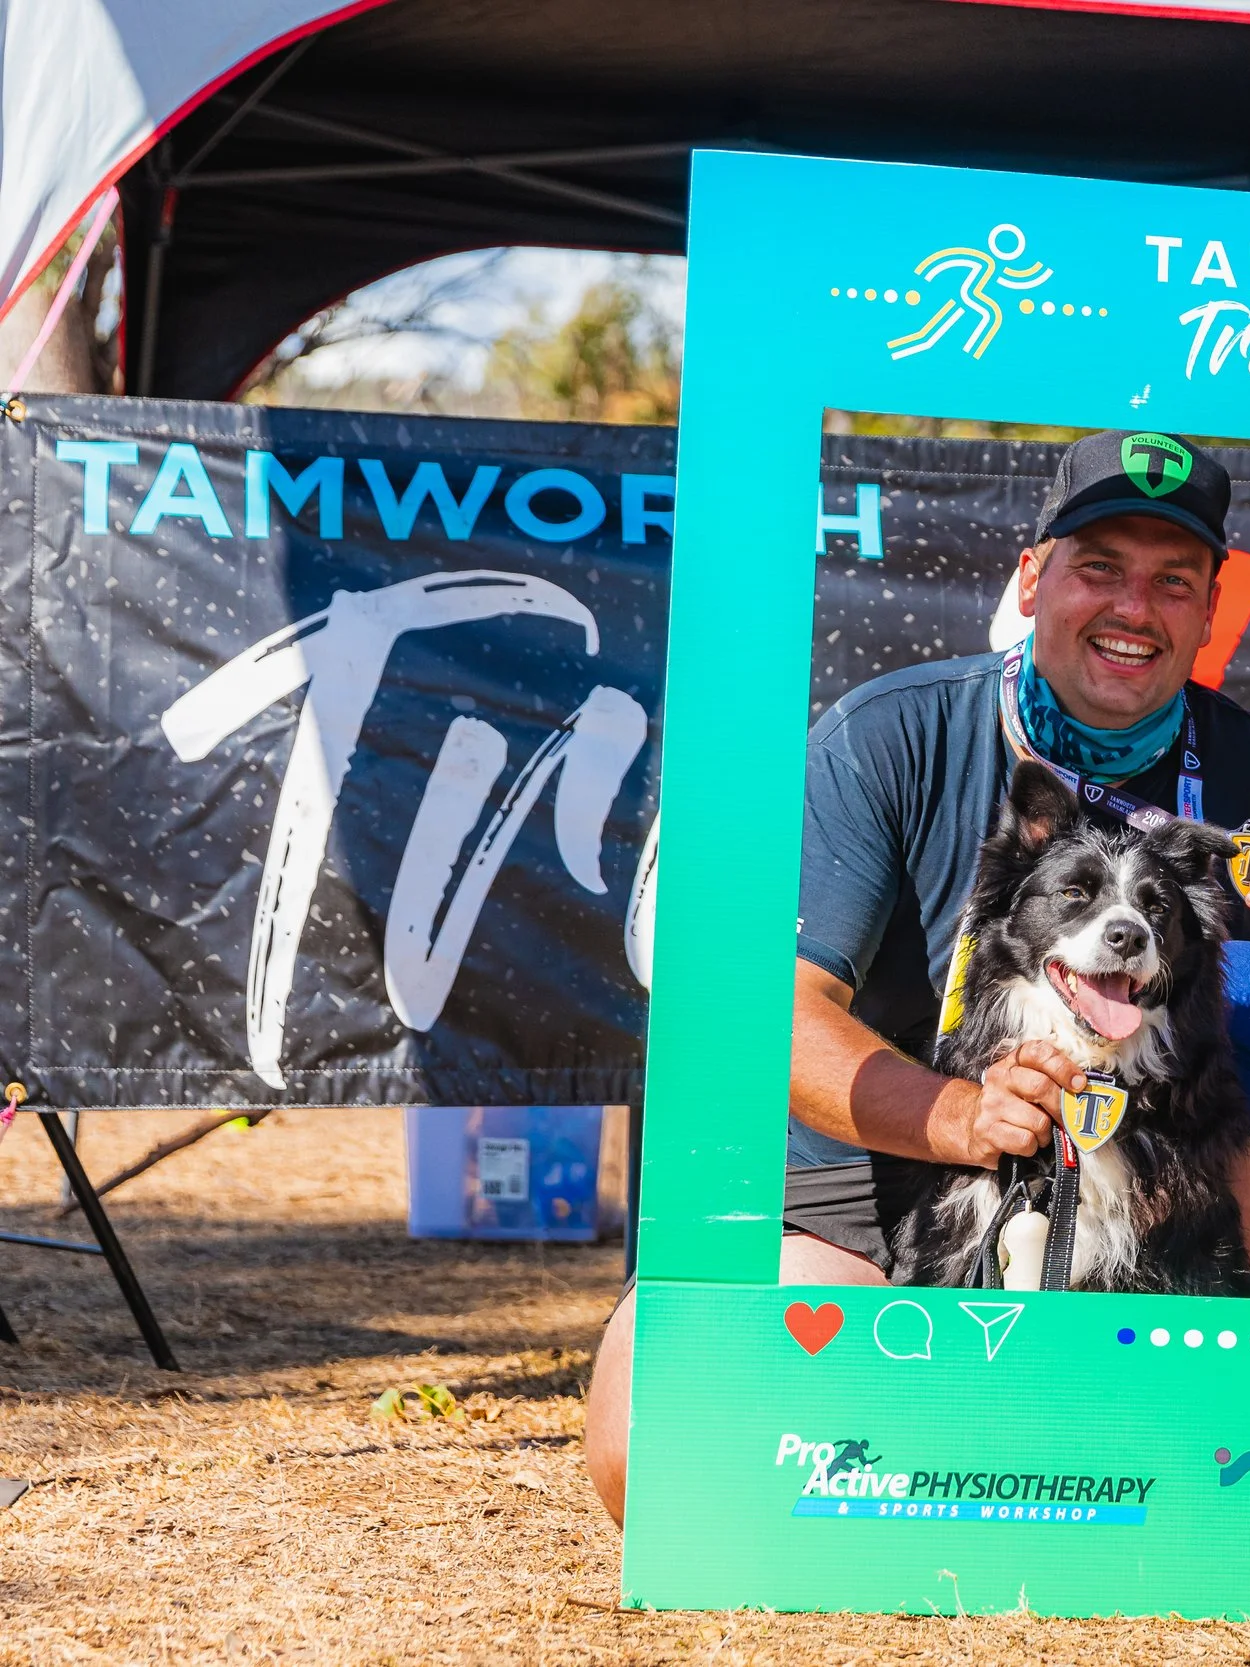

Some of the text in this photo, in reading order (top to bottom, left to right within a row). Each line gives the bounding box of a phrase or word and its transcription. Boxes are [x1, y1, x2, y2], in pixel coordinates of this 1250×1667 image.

[1131, 437, 1186, 456] VOLUNTEER
[56, 441, 884, 559] TAMWORH
[775, 1433, 836, 1467] Pro
[838, 1502, 1098, 1521] & SPORTS WORKSHOP
